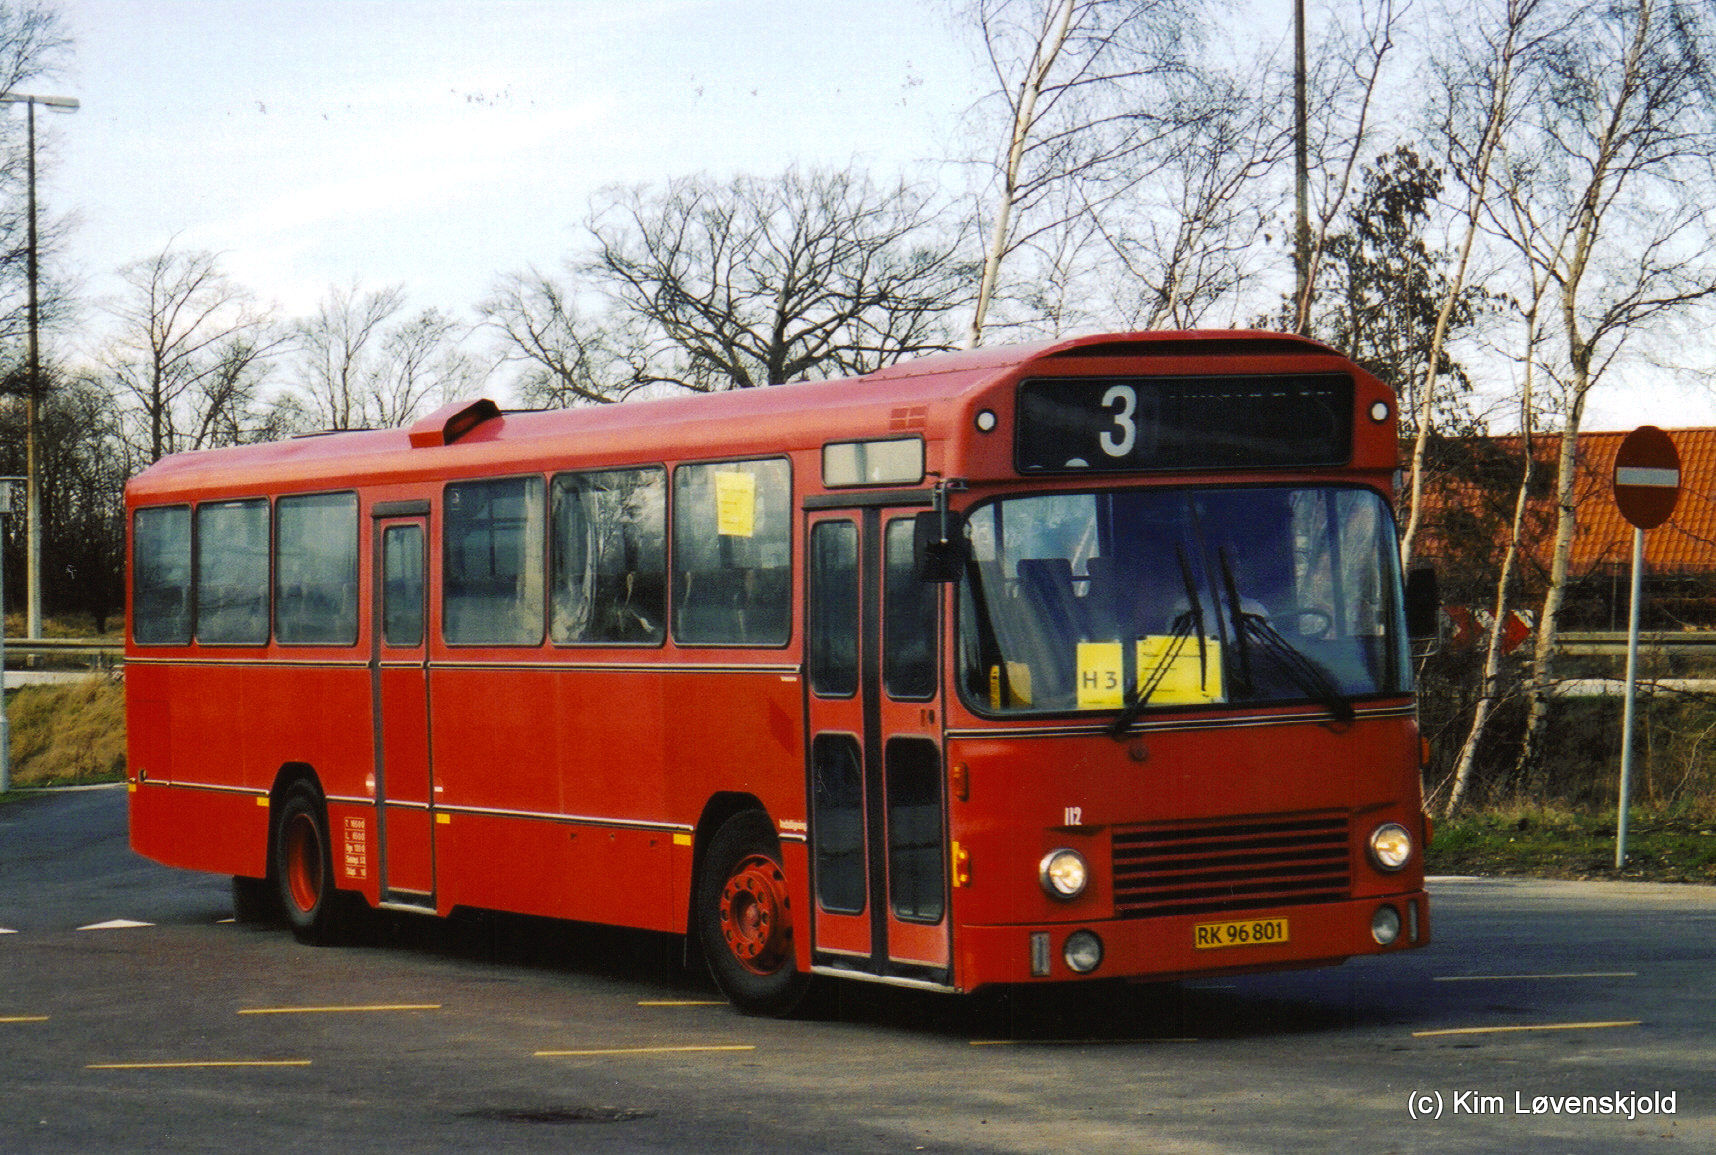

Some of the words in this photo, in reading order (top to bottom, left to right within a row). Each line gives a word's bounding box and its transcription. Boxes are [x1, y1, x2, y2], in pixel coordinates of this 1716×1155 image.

[1100, 385, 1137, 457] 3
[1083, 671, 1098, 689] H
[1105, 671, 1118, 689] 3
[1062, 806, 1083, 826] 112
[1198, 926, 1223, 945] RK
